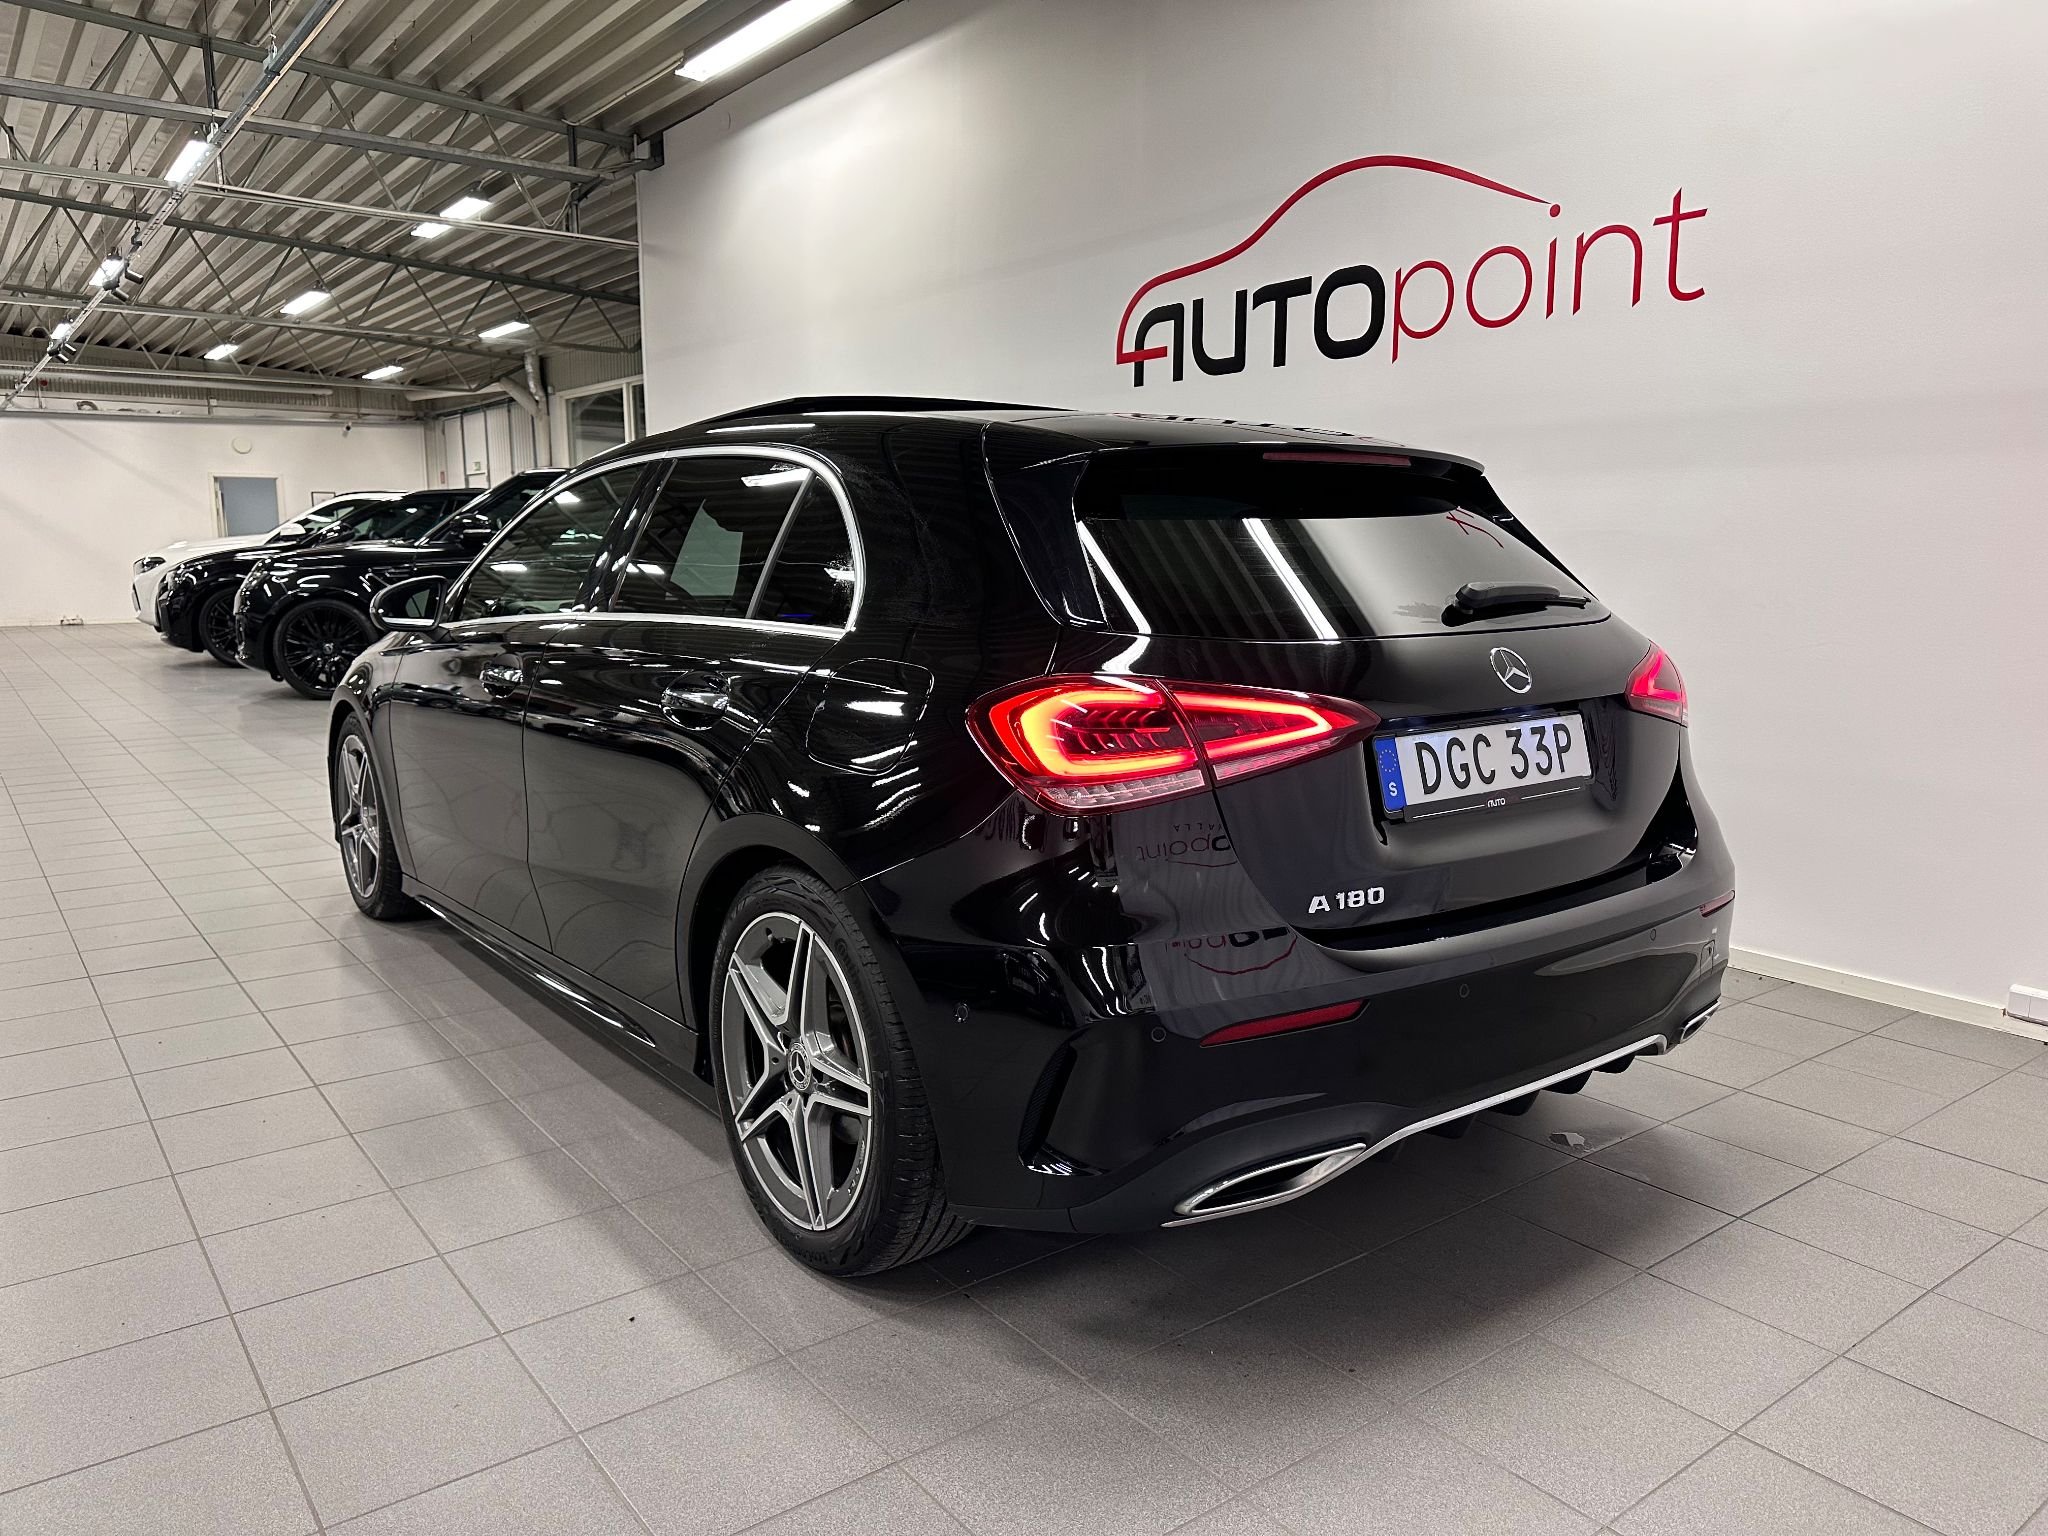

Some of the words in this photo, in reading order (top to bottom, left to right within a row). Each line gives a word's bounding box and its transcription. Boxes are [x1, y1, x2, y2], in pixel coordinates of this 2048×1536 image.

[1116, 187, 1708, 388] AUTOpoint
[1414, 732, 1496, 796] DGC
[1505, 722, 1572, 780] 33P
[1388, 781, 1398, 798] S
[1308, 895, 1331, 914] A
[1335, 886, 1385, 910] 180
